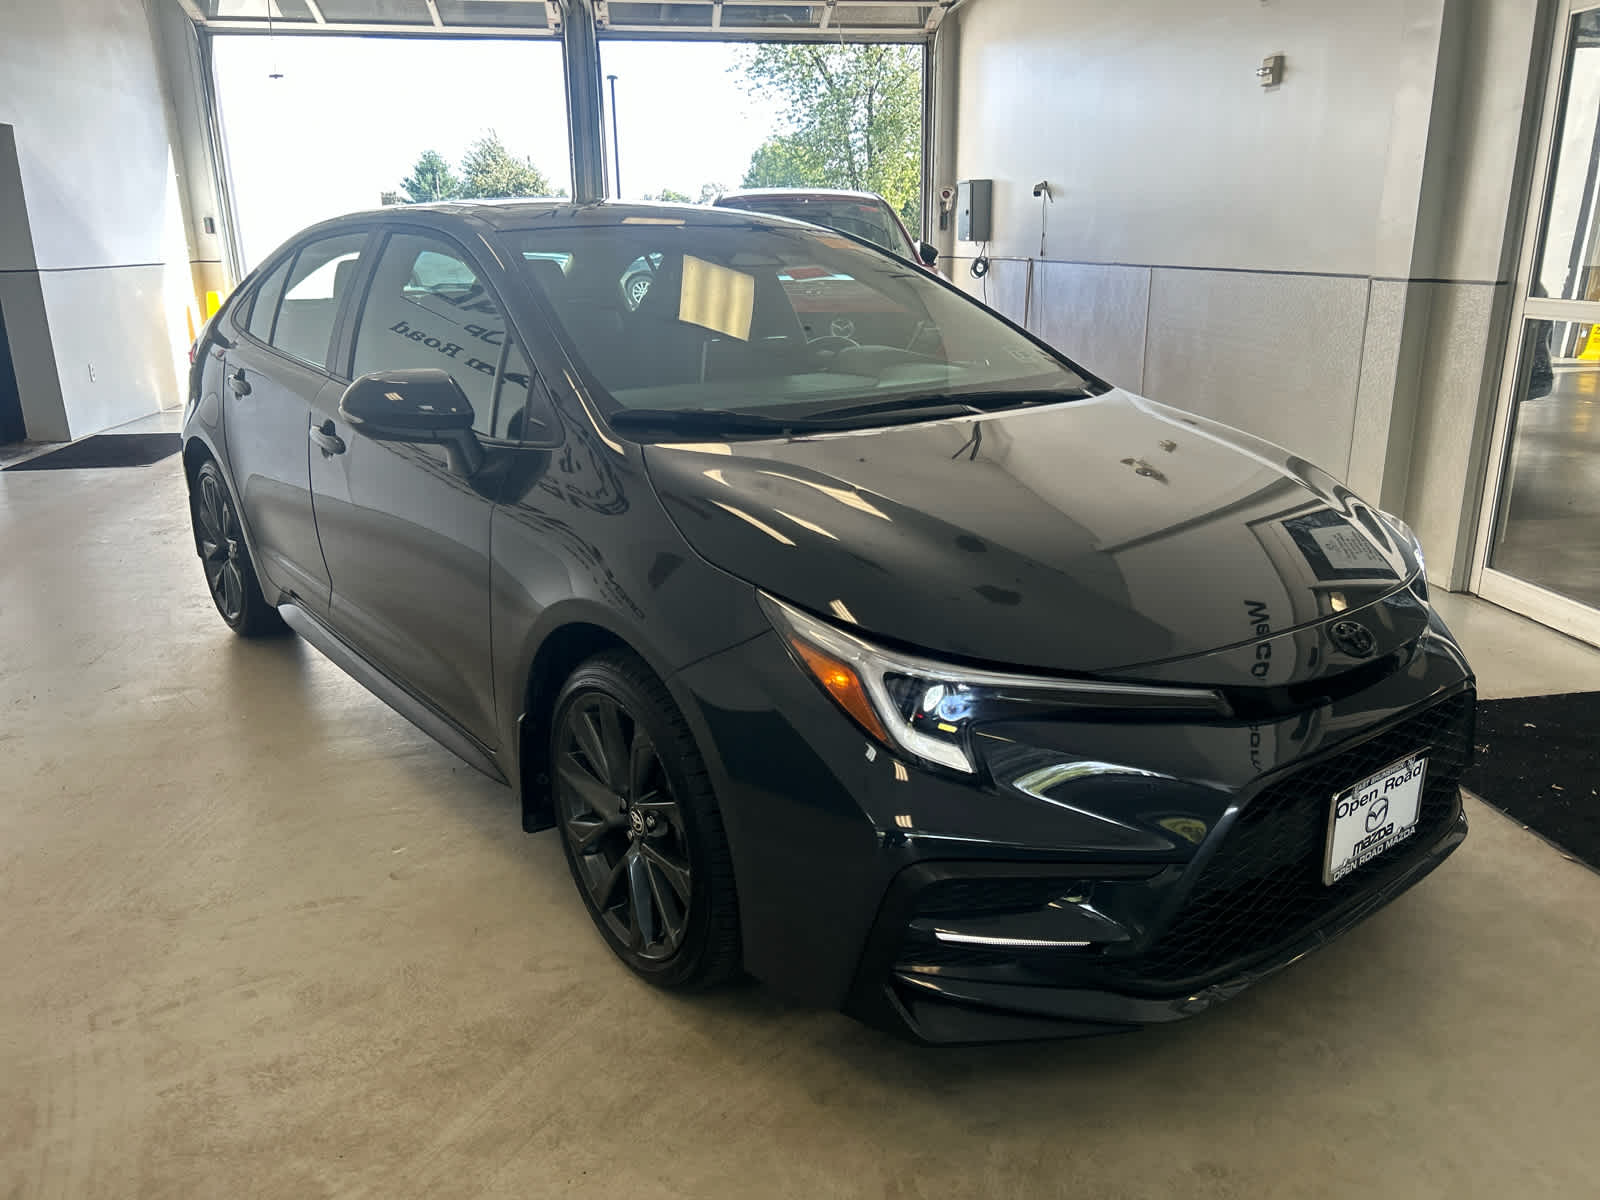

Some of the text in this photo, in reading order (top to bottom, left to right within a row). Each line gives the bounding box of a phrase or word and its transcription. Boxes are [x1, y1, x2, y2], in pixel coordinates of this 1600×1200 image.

[1336, 788, 1379, 819] Open
[1384, 761, 1423, 795] Road
[1333, 826, 1416, 882] OPEN ROAD MAZDA
[1352, 822, 1394, 857] mazda
